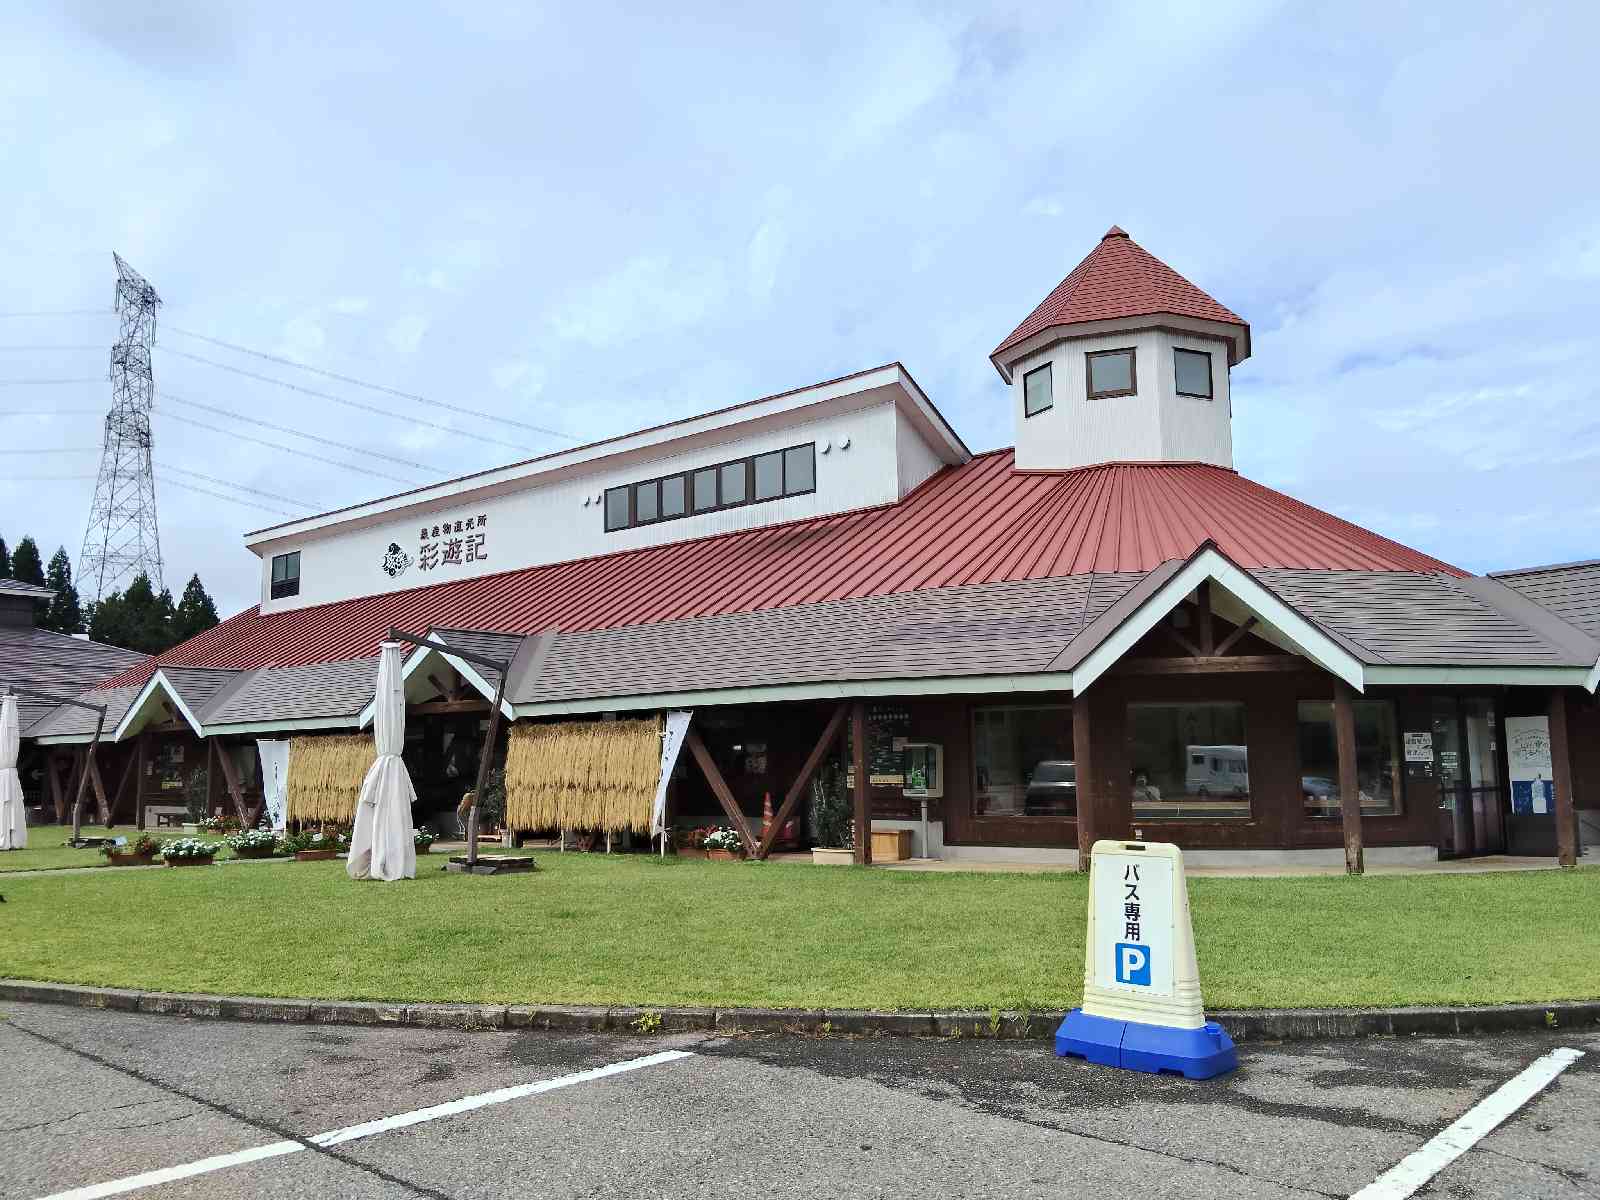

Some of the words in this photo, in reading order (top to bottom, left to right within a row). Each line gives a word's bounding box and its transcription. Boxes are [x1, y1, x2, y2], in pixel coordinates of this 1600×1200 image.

[418, 533, 488, 571] 彩遊記
[1124, 864, 1140, 941] バス専用
[1122, 947, 1145, 981] P
